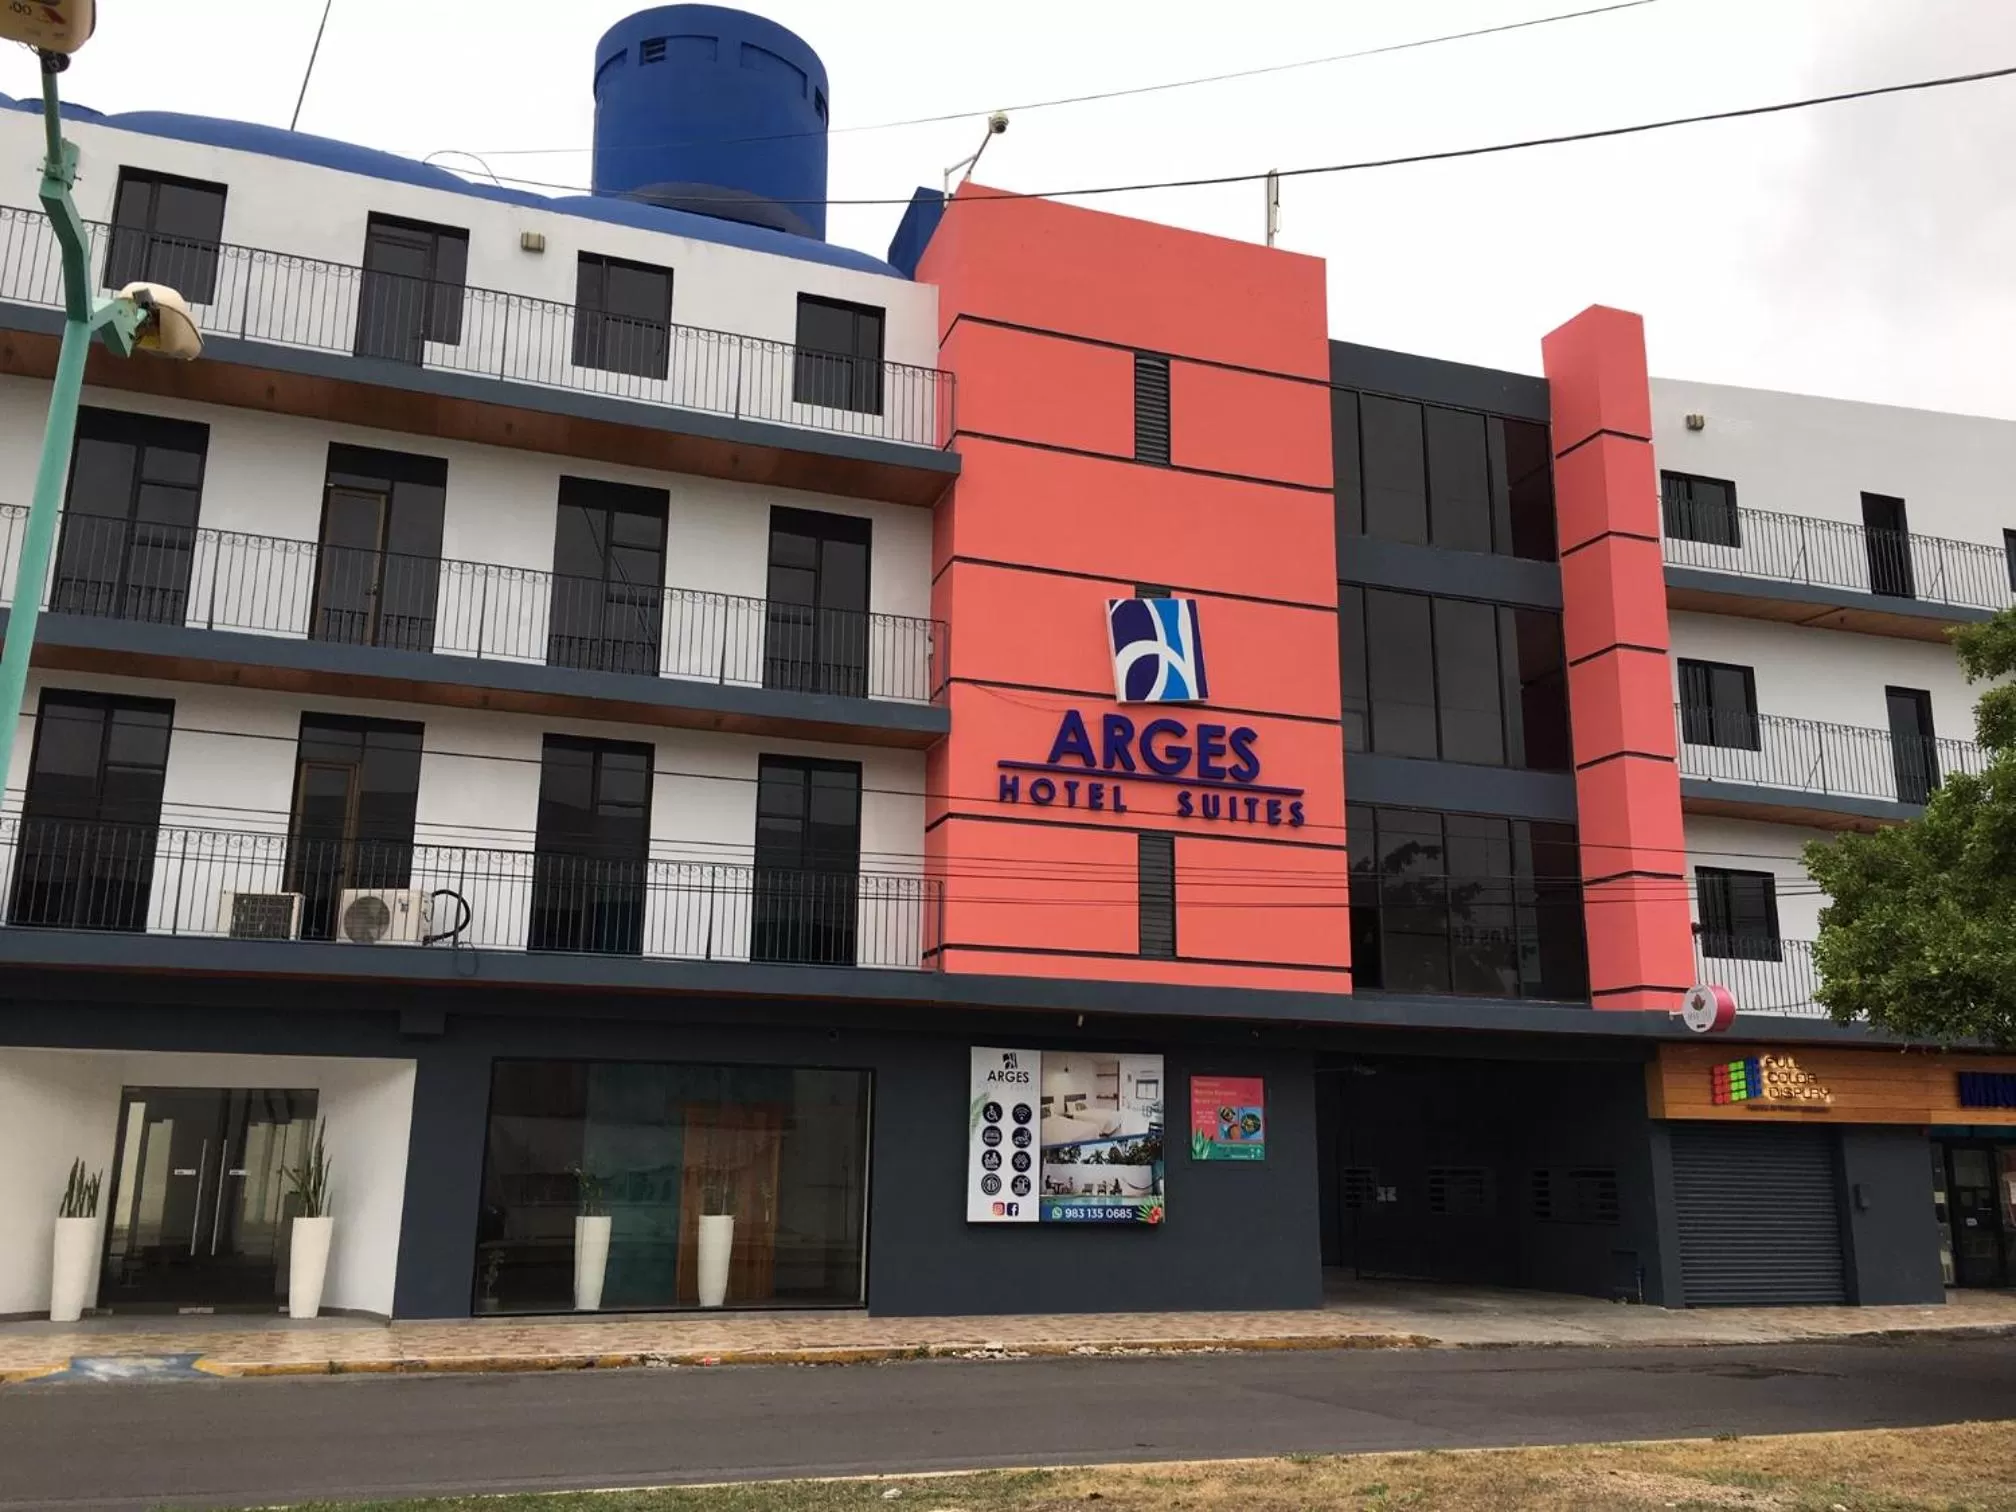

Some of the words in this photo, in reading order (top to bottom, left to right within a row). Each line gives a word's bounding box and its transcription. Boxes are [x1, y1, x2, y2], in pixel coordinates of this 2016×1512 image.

[1046, 709, 1261, 782] ARGES
[999, 774, 1127, 813] HOTEL
[1177, 790, 1306, 828] SUITES
[1765, 1056, 1802, 1070] FULL
[987, 1070, 1029, 1083] ARGES
[1767, 1071, 1818, 1084] COLOR
[1768, 1086, 1831, 1099] DISPLAY
[1065, 1208, 1084, 1218] 983
[1087, 1208, 1103, 1218] 135
[1106, 1208, 1132, 1218] 0685
